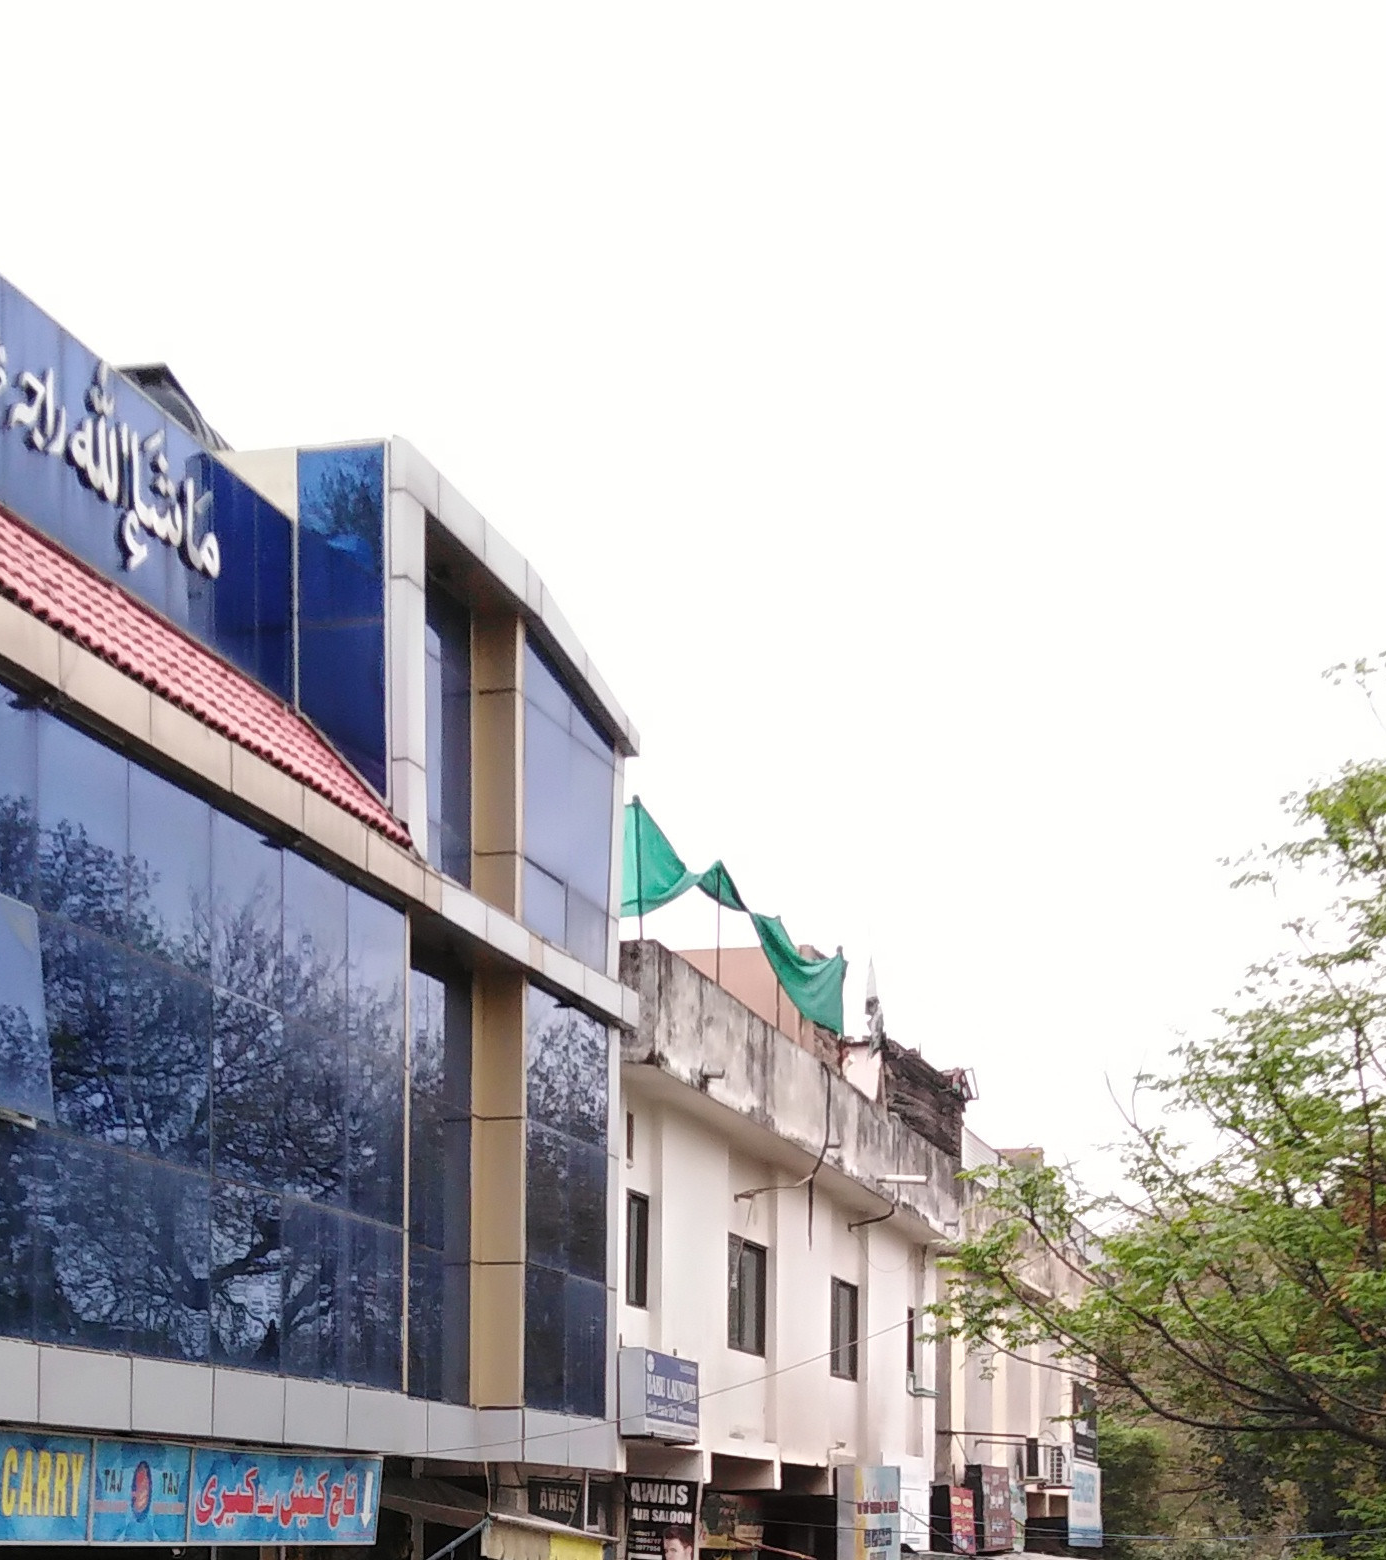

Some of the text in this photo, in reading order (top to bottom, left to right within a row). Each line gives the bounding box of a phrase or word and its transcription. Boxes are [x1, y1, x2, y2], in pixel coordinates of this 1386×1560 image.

[0, 1446, 85, 1519] CARRY
[103, 1468, 124, 1493] TAJ
[162, 1471, 181, 1495] TAJ
[328, 1470, 359, 1531] تاج
[539, 1487, 578, 1513] AWAIS
[629, 1481, 688, 1506] AWAIS
[651, 1509, 692, 1525] SALOON
